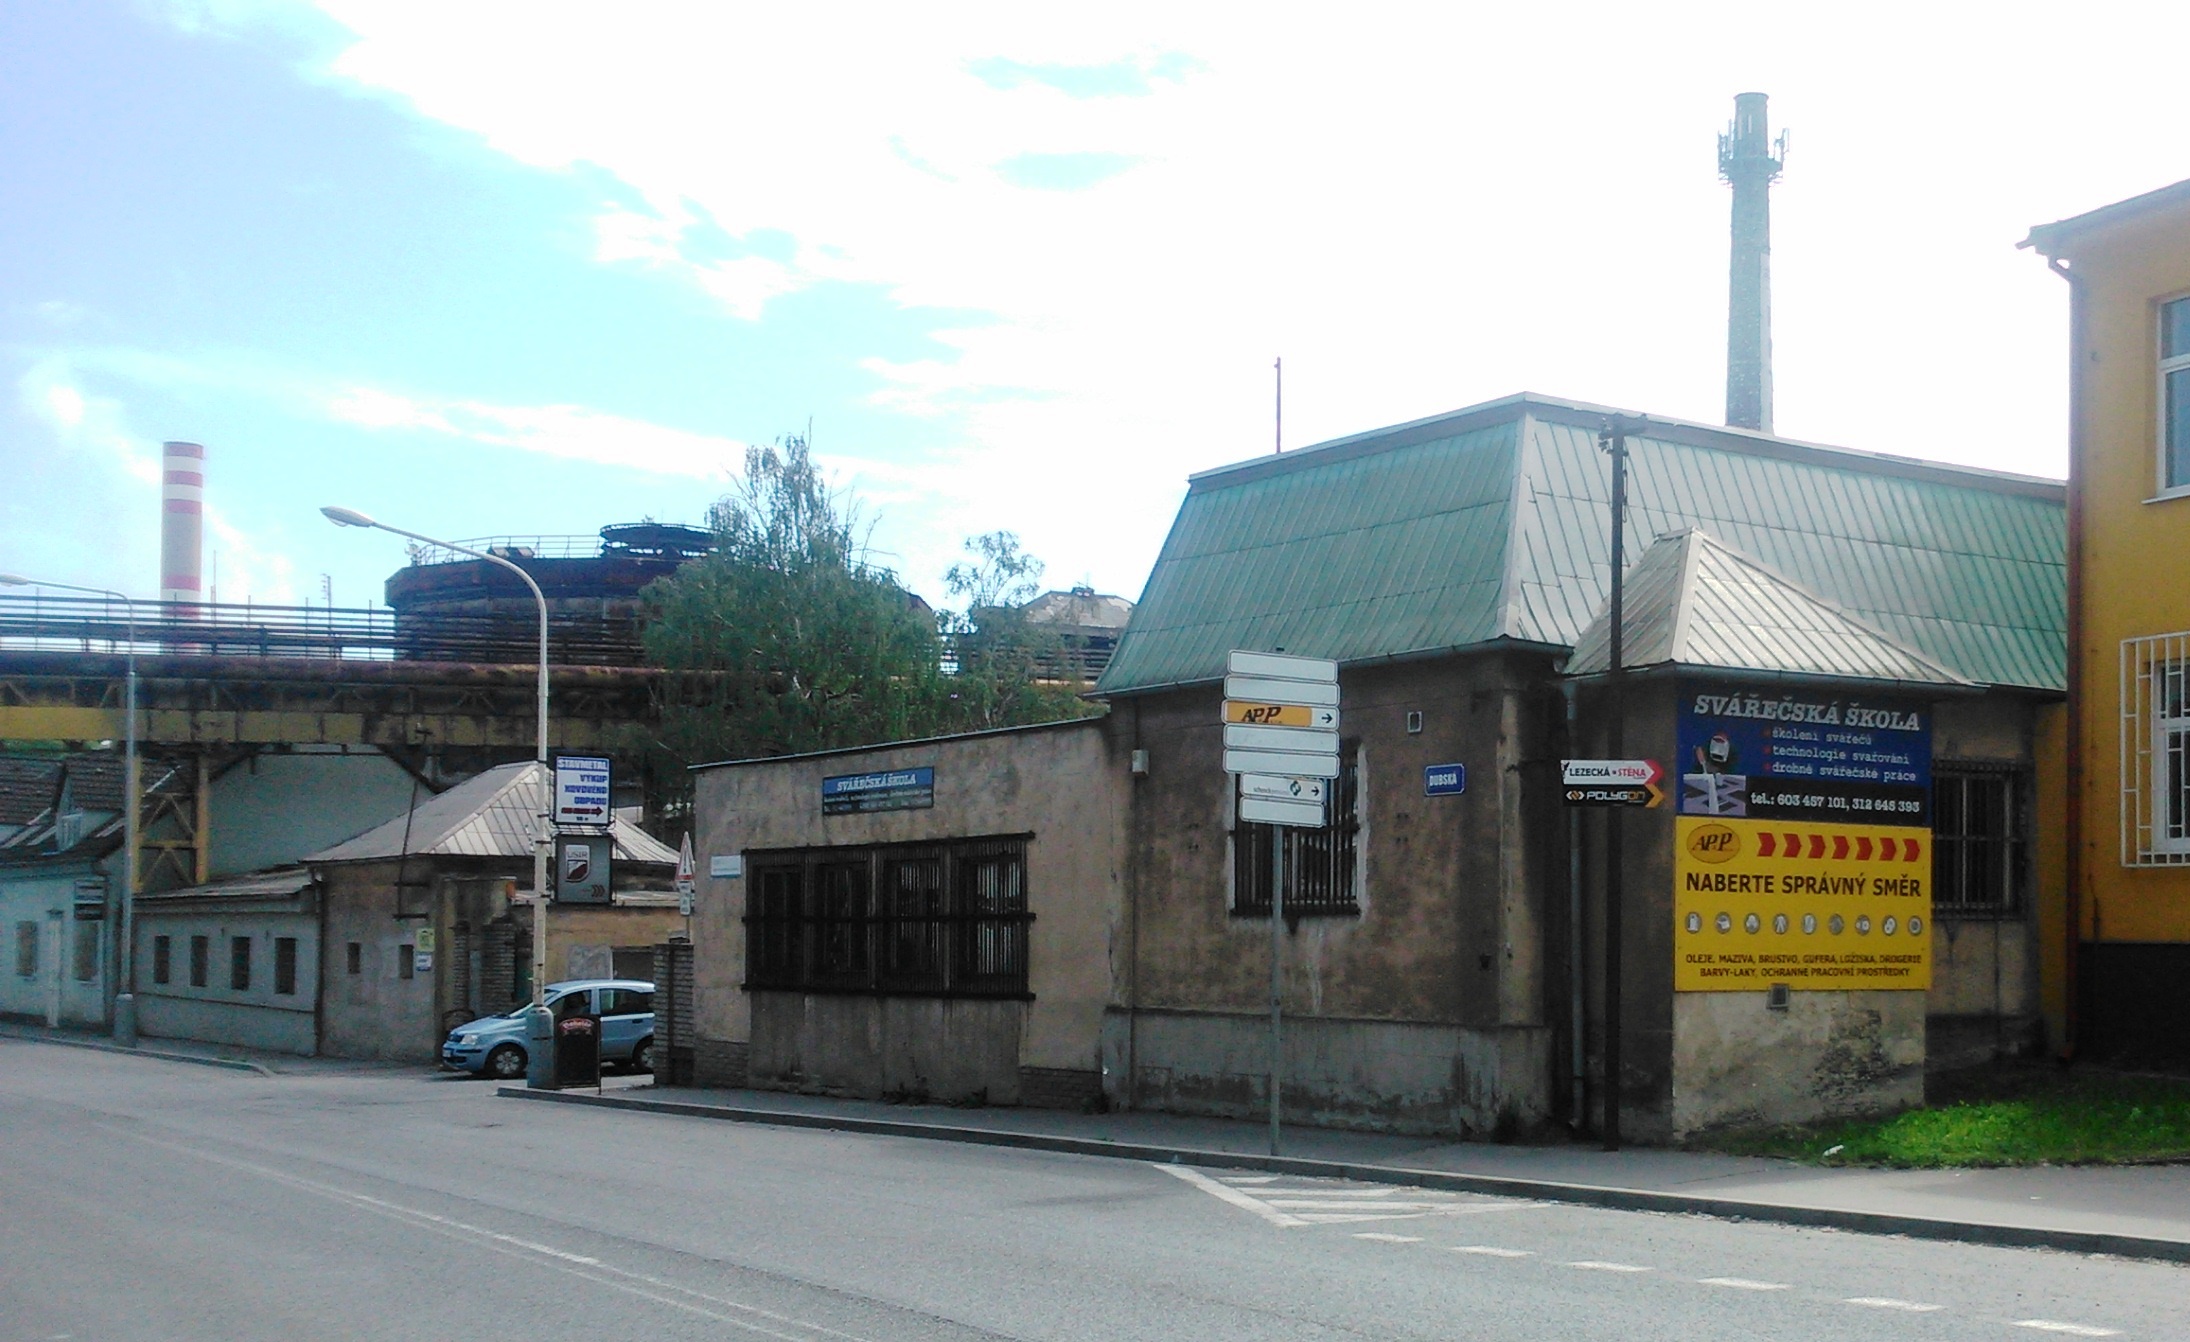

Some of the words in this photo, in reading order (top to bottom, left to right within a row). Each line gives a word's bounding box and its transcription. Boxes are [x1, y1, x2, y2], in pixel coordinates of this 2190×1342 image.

[1241, 706, 1282, 723] APP
[1694, 693, 1839, 725] SVÁŘEČSKÁ
[1844, 702, 1920, 731] ŠKOLA
[1772, 728, 1819, 741] školení
[1772, 745, 1846, 761] technologie
[557, 759, 607, 770] STAVMETAL
[1569, 766, 1610, 777] LEZECKÁ
[1617, 766, 1646, 777] STĚNA
[1772, 761, 1813, 775] drobné
[1820, 765, 1879, 779] svářečské
[1883, 770, 1917, 782] práce
[837, 775, 887, 792] SVÁŘEČSKÁ
[887, 773, 916, 787] ŠKOLA
[1429, 772, 1458, 787] DUBSKÁ
[1586, 791, 1646, 801] POLYGON
[1750, 792, 1775, 805] tel.:
[1777, 794, 1800, 806] 603
[1802, 795, 1824, 807] 457
[1827, 797, 1850, 811] 101,
[1852, 798, 1872, 811] 312
[1898, 801, 1920, 813] 393
[1692, 832, 1733, 851] APP
[1686, 872, 1775, 893] NABERTE
[1781, 872, 1866, 896] SPRÁVNÝ
[1873, 874, 1921, 897] SMĚR
[1879, 954, 1922, 963] DROGERIE
[1811, 966, 1854, 976] PRACOVNÍ
[1857, 966, 1910, 976] PROSTŘEDKY
